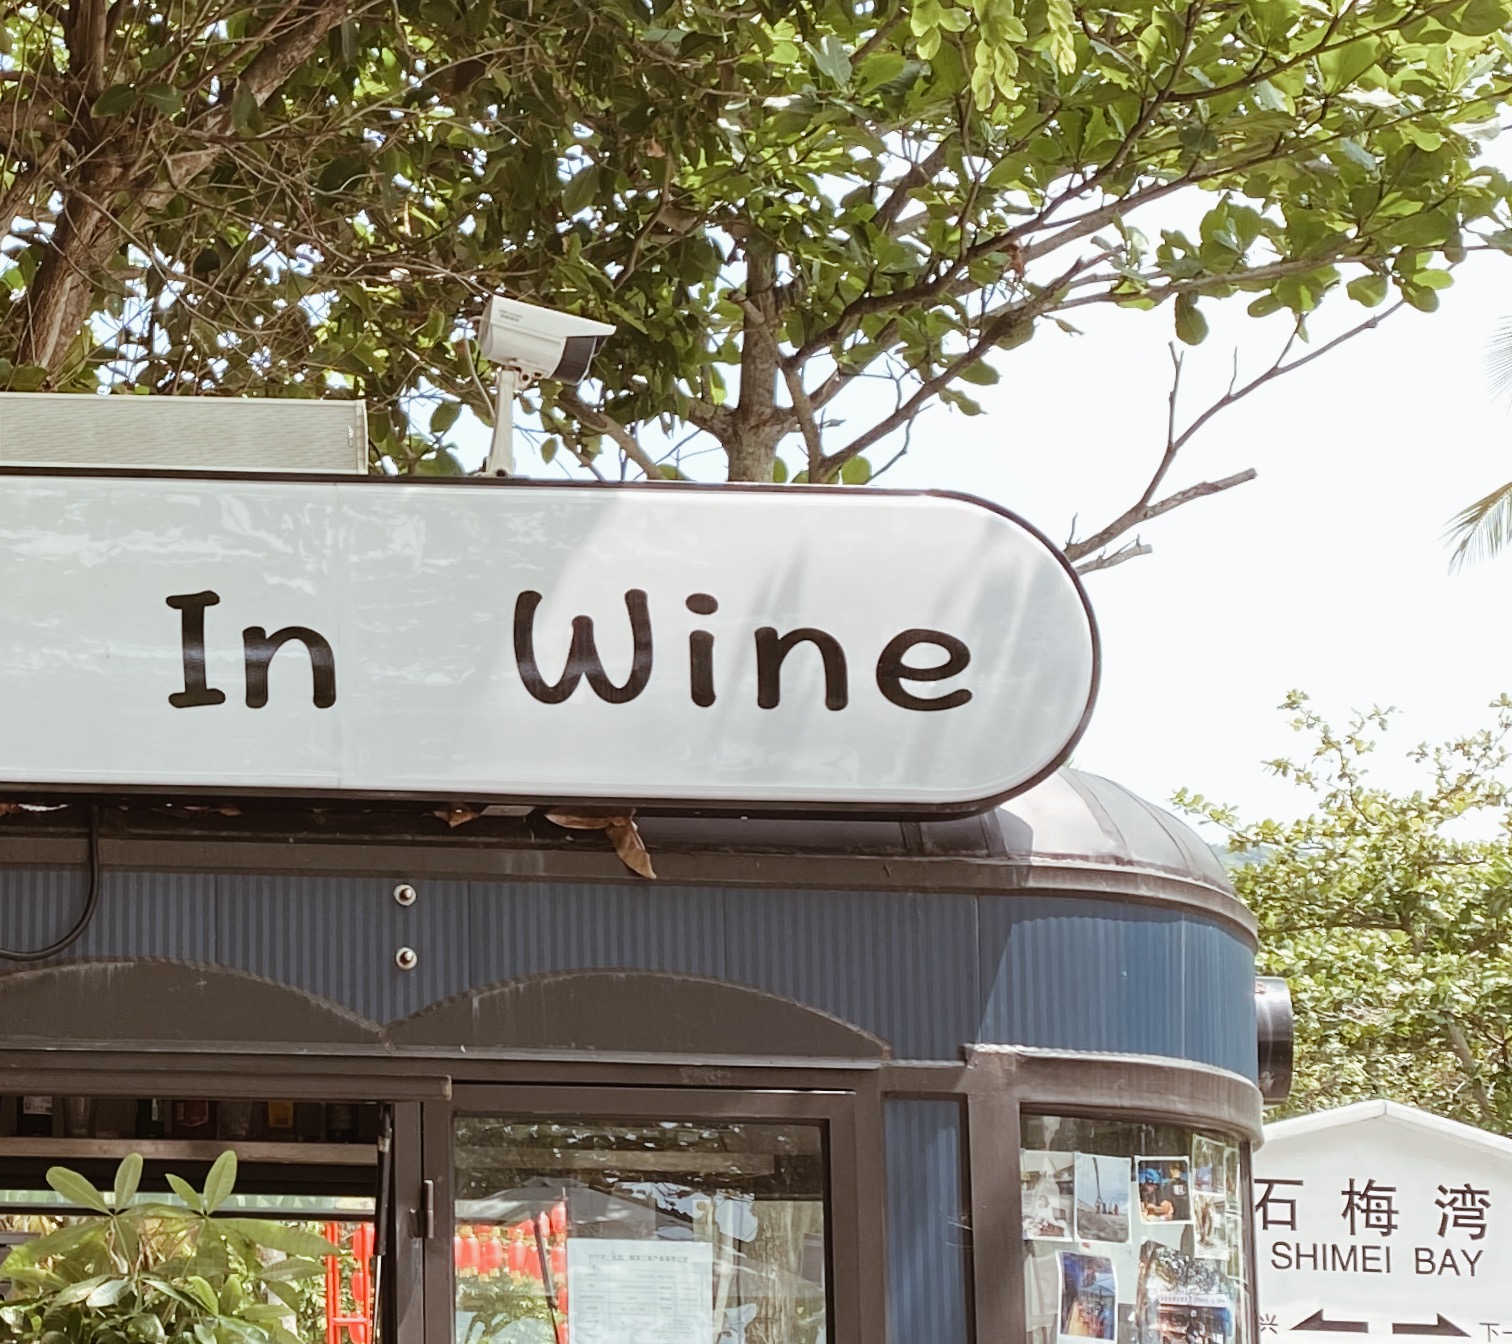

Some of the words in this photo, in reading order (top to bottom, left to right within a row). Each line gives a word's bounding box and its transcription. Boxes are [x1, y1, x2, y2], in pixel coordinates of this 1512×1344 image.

[165, 590, 336, 709] In
[513, 589, 973, 712] Wine
[1254, 1178, 1492, 1241] 石梅湾
[1271, 1241, 1391, 1274] SHIMEI
[1415, 1247, 1484, 1277] BAY
